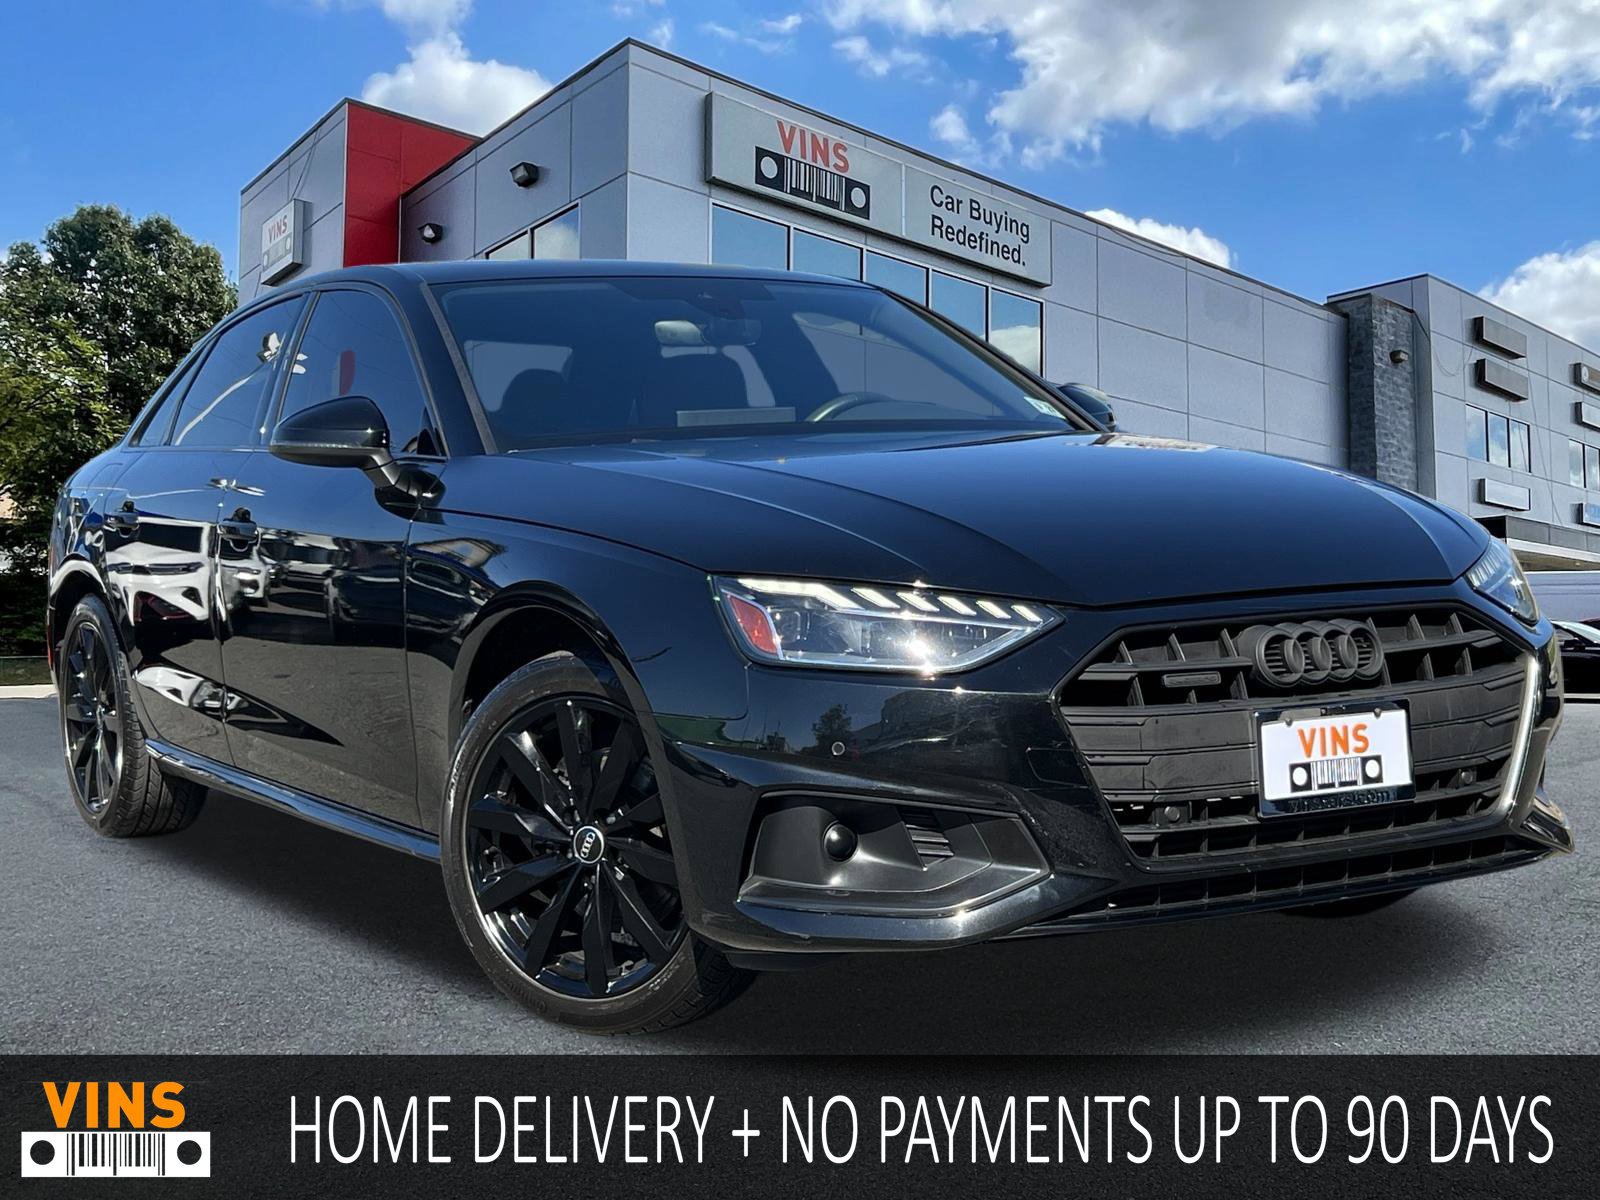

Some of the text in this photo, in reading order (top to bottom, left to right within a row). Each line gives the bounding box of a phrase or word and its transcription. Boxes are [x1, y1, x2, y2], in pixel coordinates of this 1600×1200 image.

[776, 119, 850, 174] VINS
[267, 214, 288, 244] VINS
[929, 184, 1031, 244] Car Buying
[931, 216, 1027, 267] Redefined.
[1297, 722, 1370, 759] VINS
